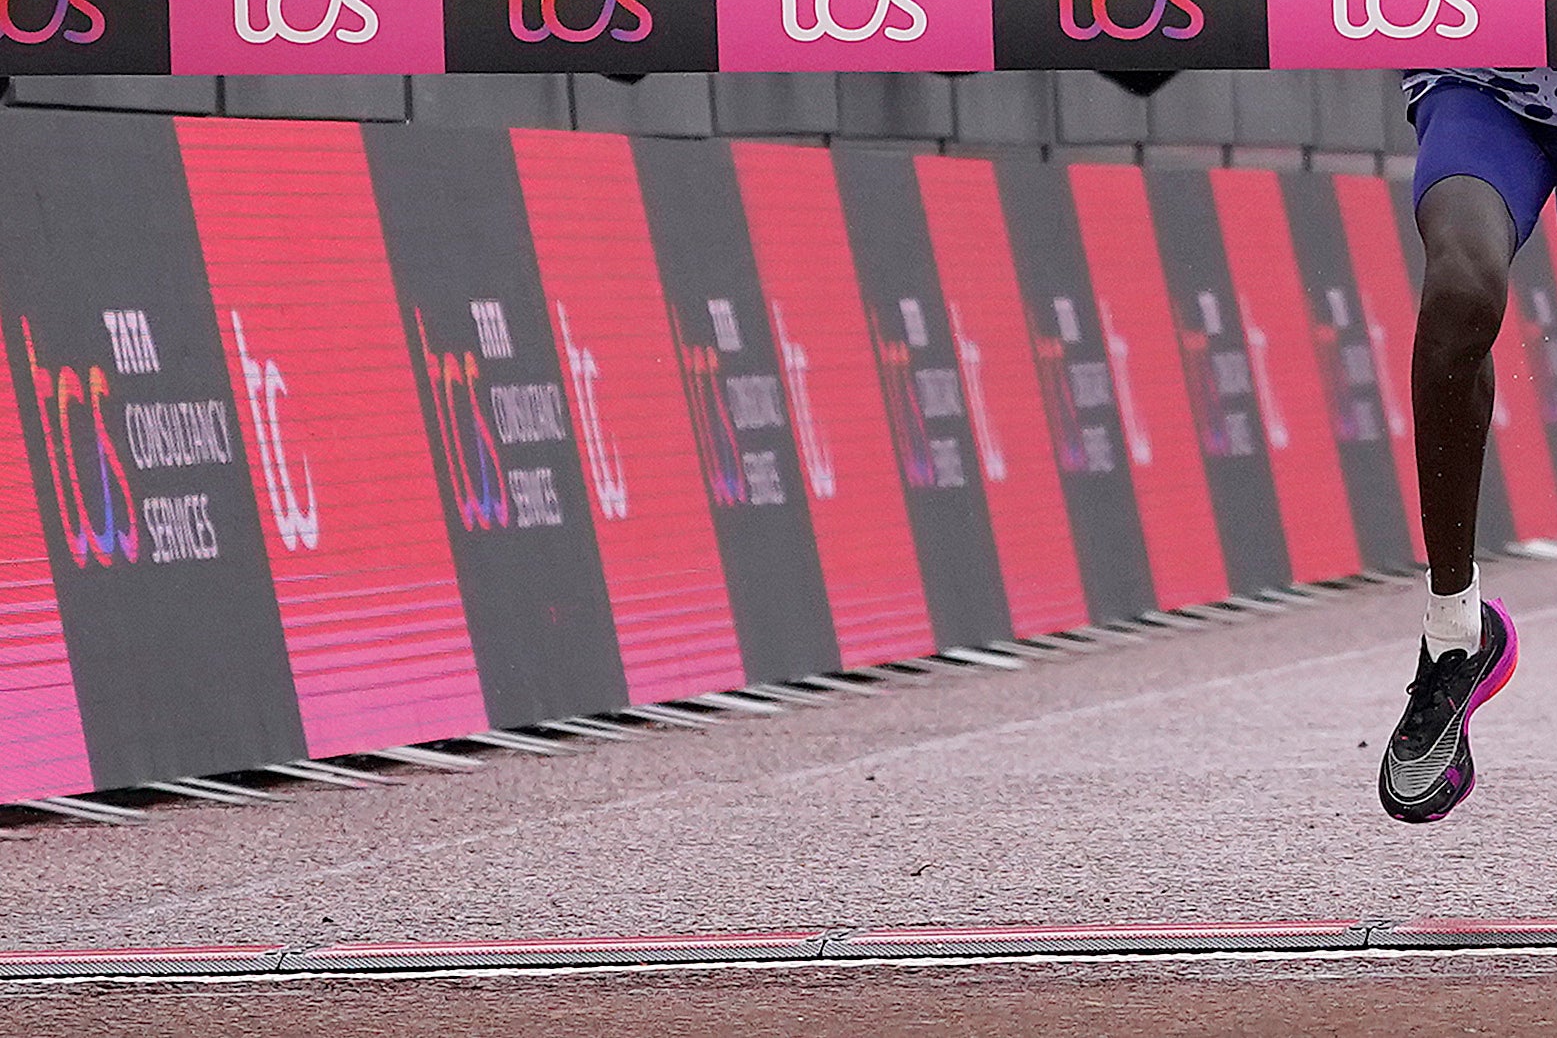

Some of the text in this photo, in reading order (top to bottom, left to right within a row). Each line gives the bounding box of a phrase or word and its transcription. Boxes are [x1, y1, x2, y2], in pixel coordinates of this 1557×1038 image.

[102, 309, 161, 374] TATA
[20, 315, 138, 568] tcs
[125, 399, 232, 469] CONSULTANCY
[414, 306, 508, 532] tcs
[143, 493, 219, 563] SERVICES
